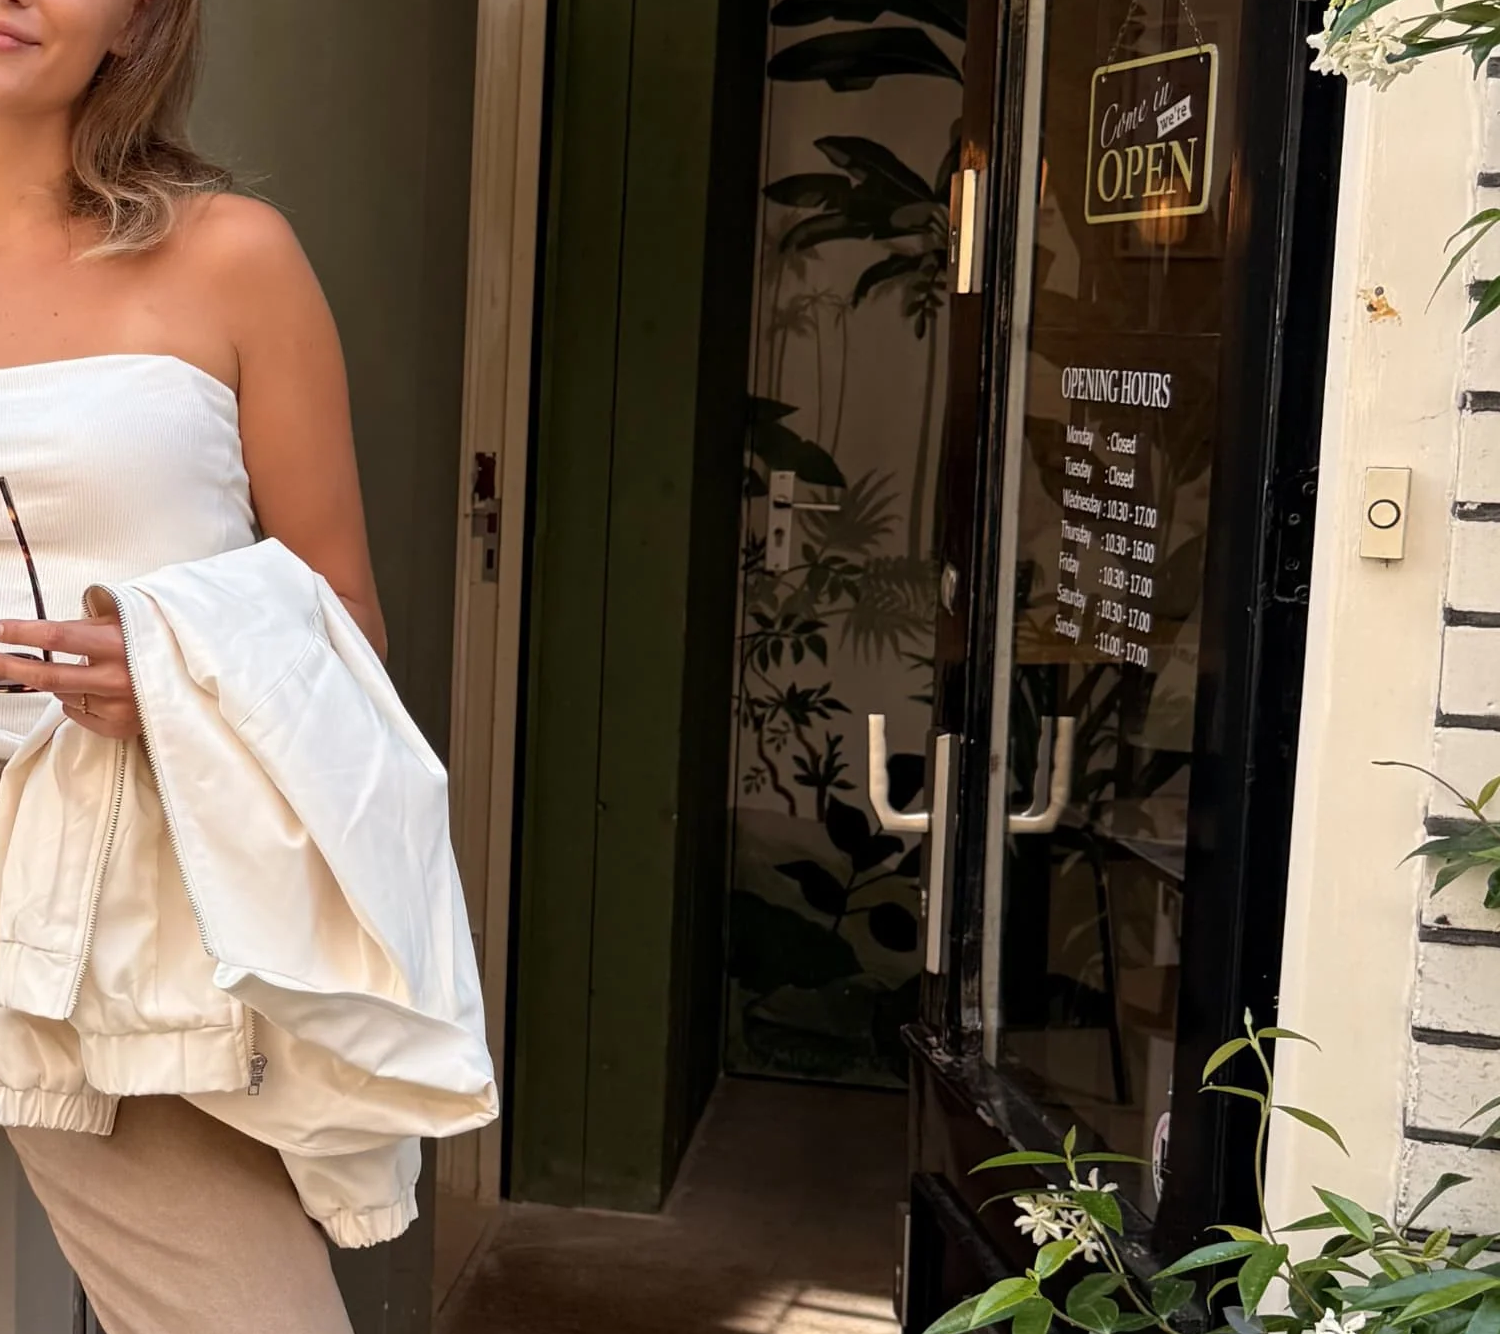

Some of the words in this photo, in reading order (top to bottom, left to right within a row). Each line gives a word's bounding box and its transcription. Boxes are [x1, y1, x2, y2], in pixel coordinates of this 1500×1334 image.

[1100, 98, 1148, 148] Come
[1153, 76, 1174, 112] in
[1159, 103, 1189, 132] we're
[1097, 137, 1199, 203] OPEN
[1061, 366, 1120, 403] OPENING
[1120, 370, 1172, 409] HOURS
[1066, 424, 1094, 452] Monday
[1064, 456, 1093, 484] Tuesday
[1062, 488, 1102, 519] Wednesday
[1061, 520, 1092, 550] Thursday
[1059, 551, 1080, 579] Friday
[1056, 583, 1088, 616] Saturday
[1054, 614, 1080, 645] Sunday
